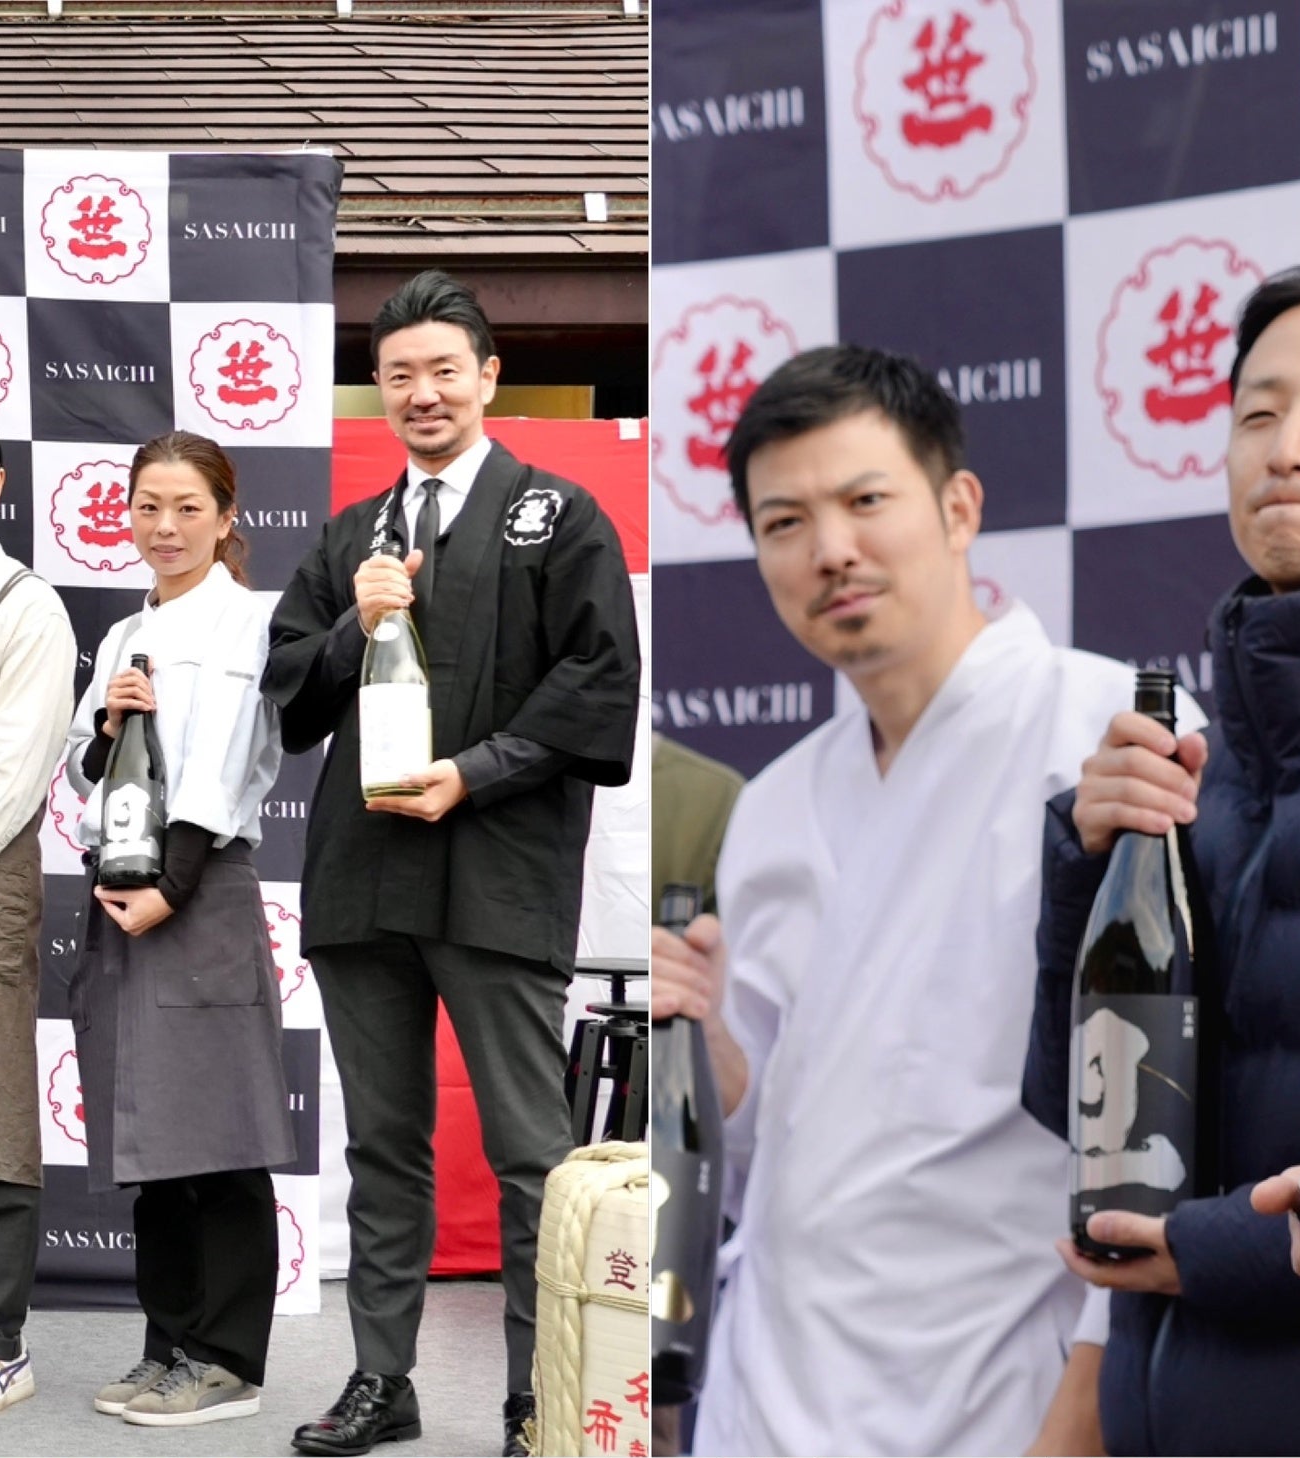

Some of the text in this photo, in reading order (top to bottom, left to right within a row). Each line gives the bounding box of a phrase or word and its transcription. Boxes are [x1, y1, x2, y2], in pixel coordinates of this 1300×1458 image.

[1087, 13, 1276, 79] SASAICHI
[185, 223, 295, 239] SASAICHI
[46, 363, 154, 381] SASAICHI
[604, 1249, 649, 1291] 登
